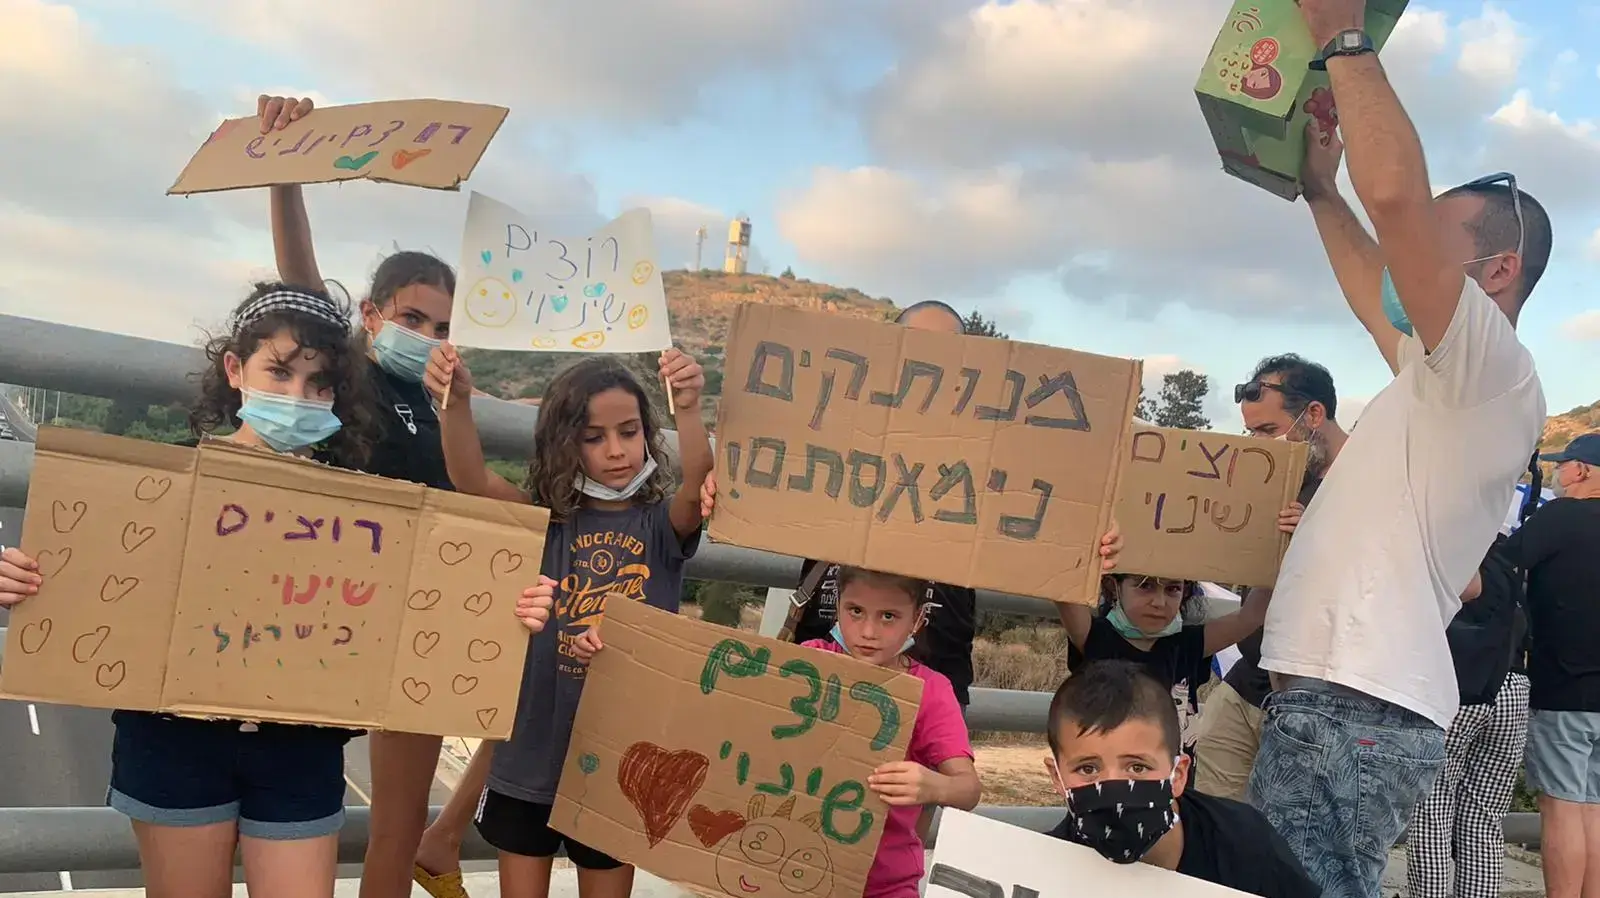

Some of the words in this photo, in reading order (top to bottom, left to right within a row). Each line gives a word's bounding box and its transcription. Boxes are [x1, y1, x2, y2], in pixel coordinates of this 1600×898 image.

[505, 224, 618, 281] רוצים
[744, 340, 1092, 433] מנותקים
[1131, 431, 1276, 487] רוצים
[215, 503, 383, 555] רוצים
[1145, 492, 1252, 533] שינוי
[271, 574, 380, 607] שינוי
[718, 740, 875, 846] שינוי
